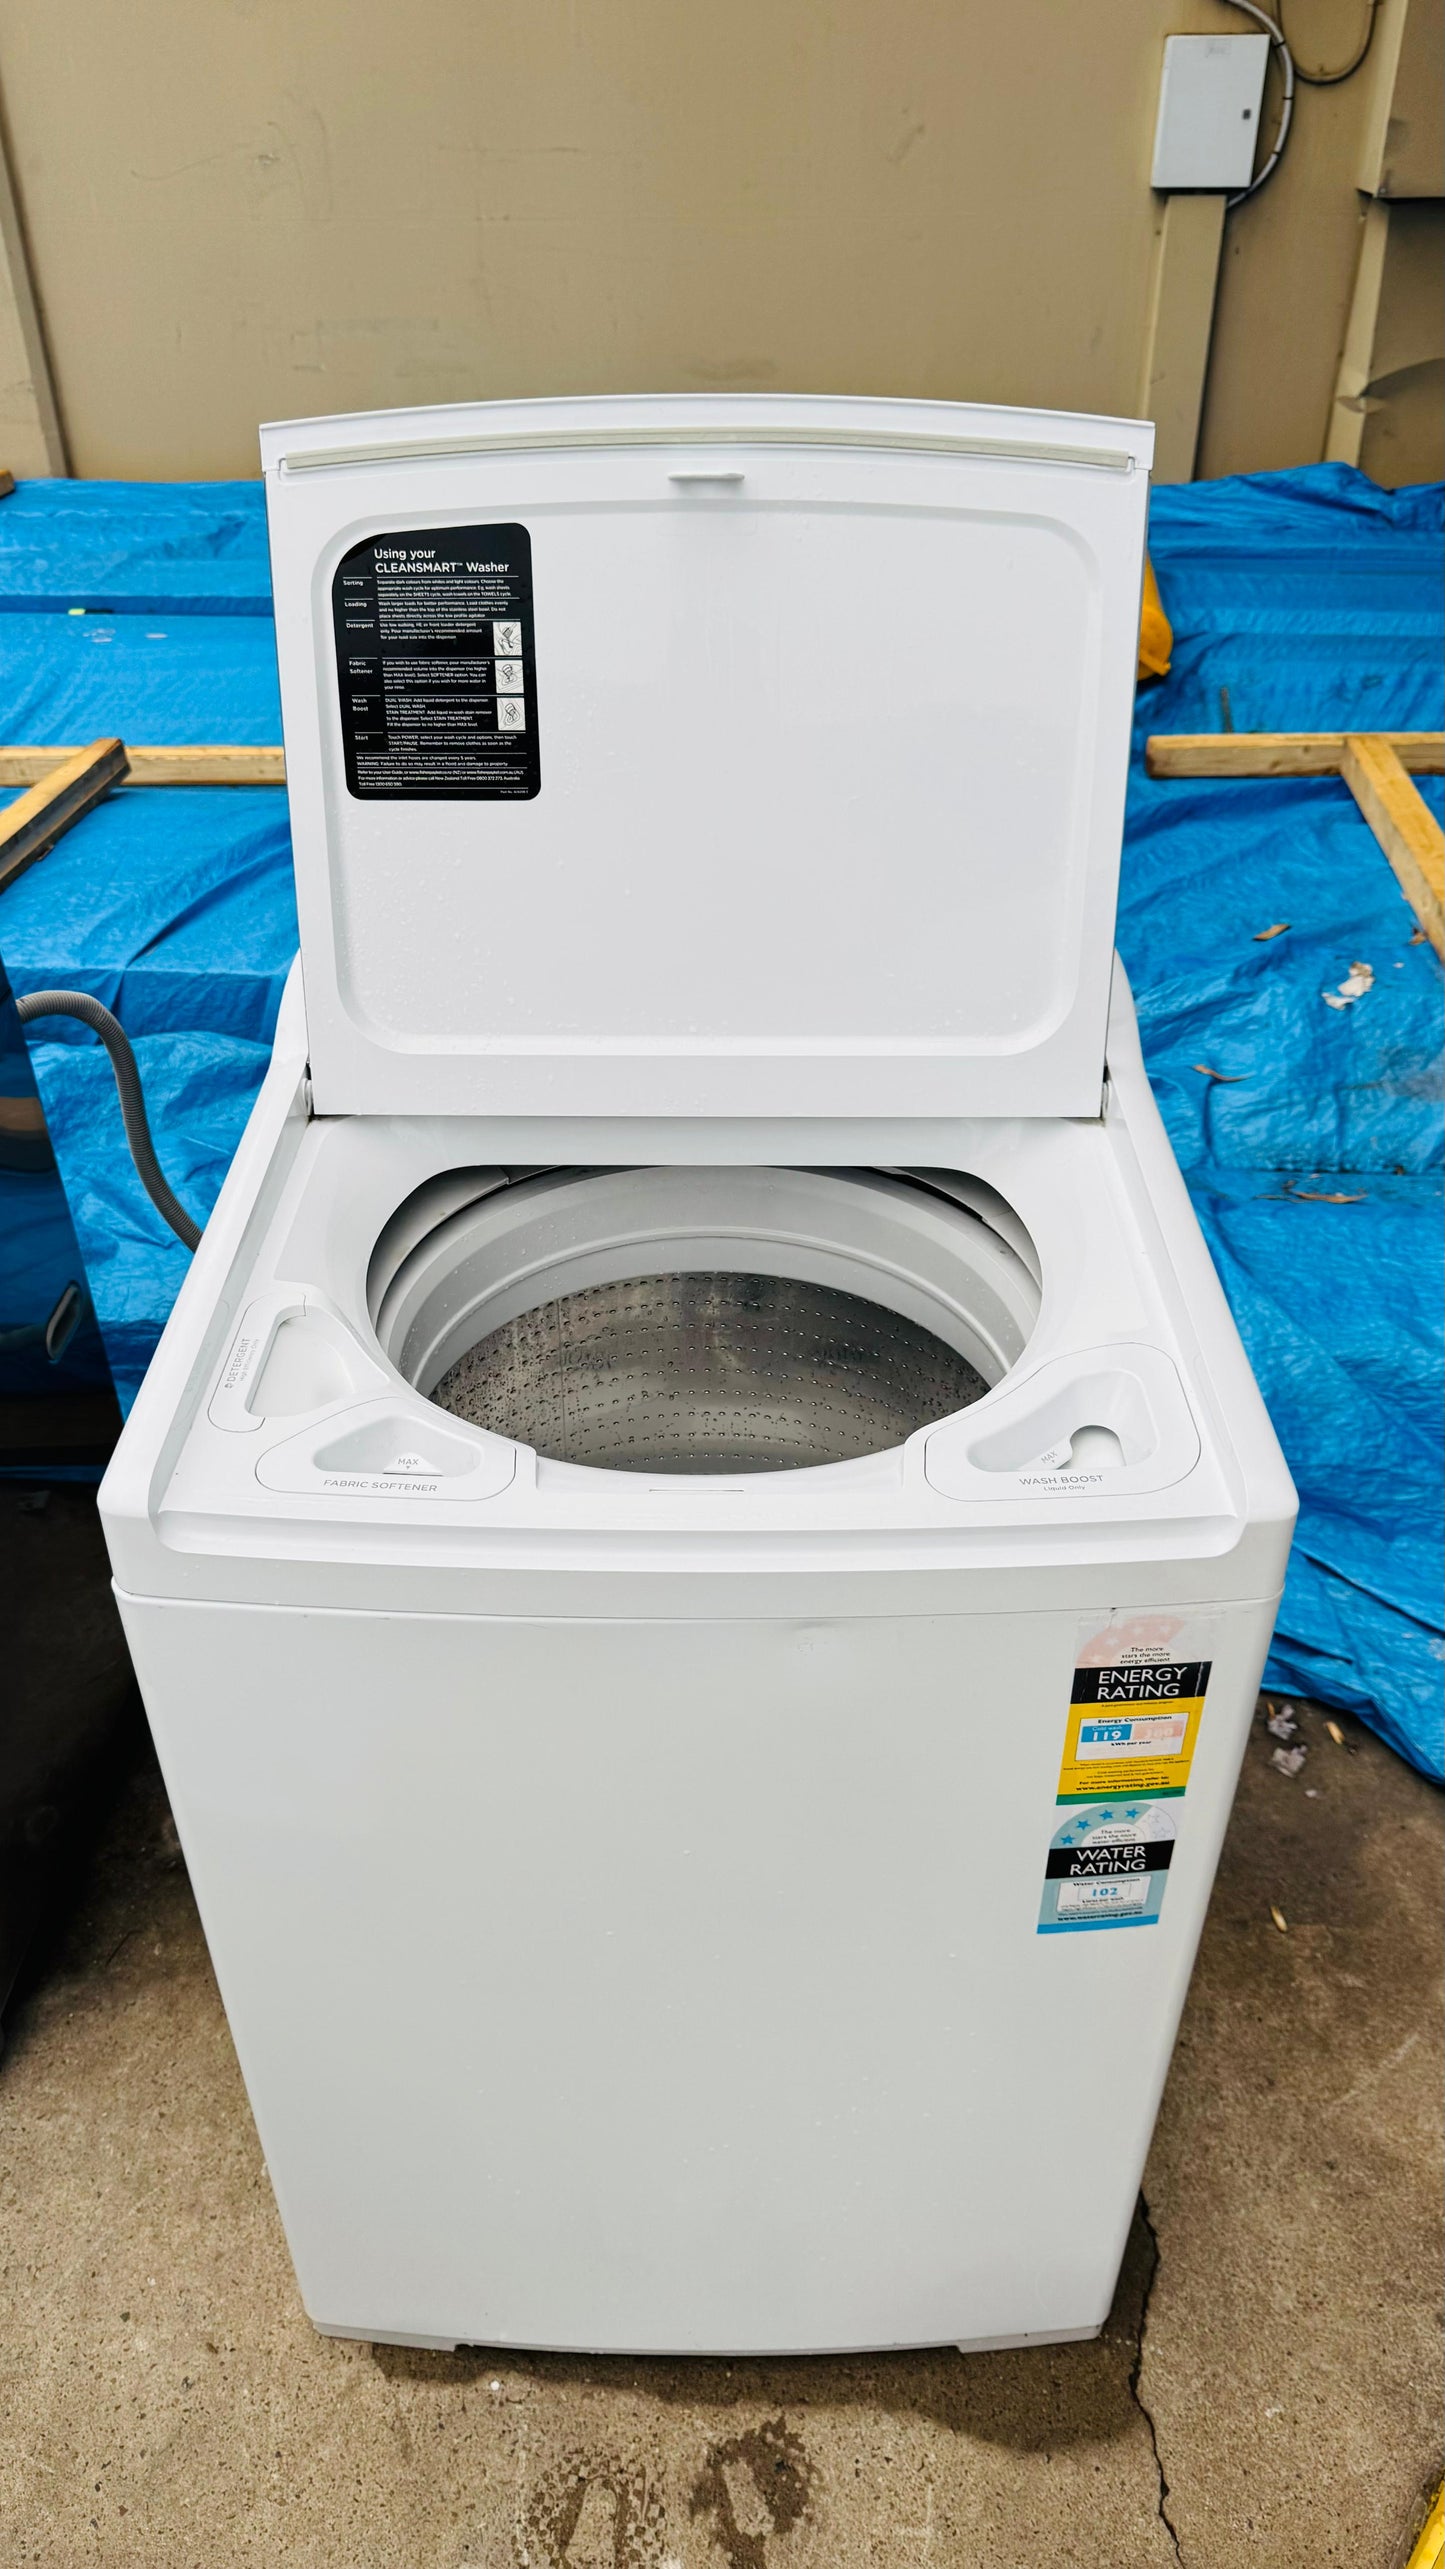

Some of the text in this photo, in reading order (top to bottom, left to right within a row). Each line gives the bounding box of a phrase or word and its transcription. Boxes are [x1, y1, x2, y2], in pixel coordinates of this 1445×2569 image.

[374, 548, 436, 560] Using your
[466, 562, 509, 573] Washer
[227, 1339, 250, 1381] DETERGENT
[1041, 1450, 1058, 1464] MAX
[324, 1479, 437, 1492] FABRIC SOFTENER
[1019, 1474, 1104, 1485] WASH BOOST
[1098, 1667, 1188, 1684] ENERGY
[1097, 1683, 1180, 1700] RATING
[1093, 1731, 1122, 1741] 119
[1076, 1781, 1170, 1791] www.energyrating.gov.au
[1076, 1846, 1146, 1861] WATER
[1070, 1859, 1146, 1875] RATING
[1092, 1887, 1118, 1897] 102
